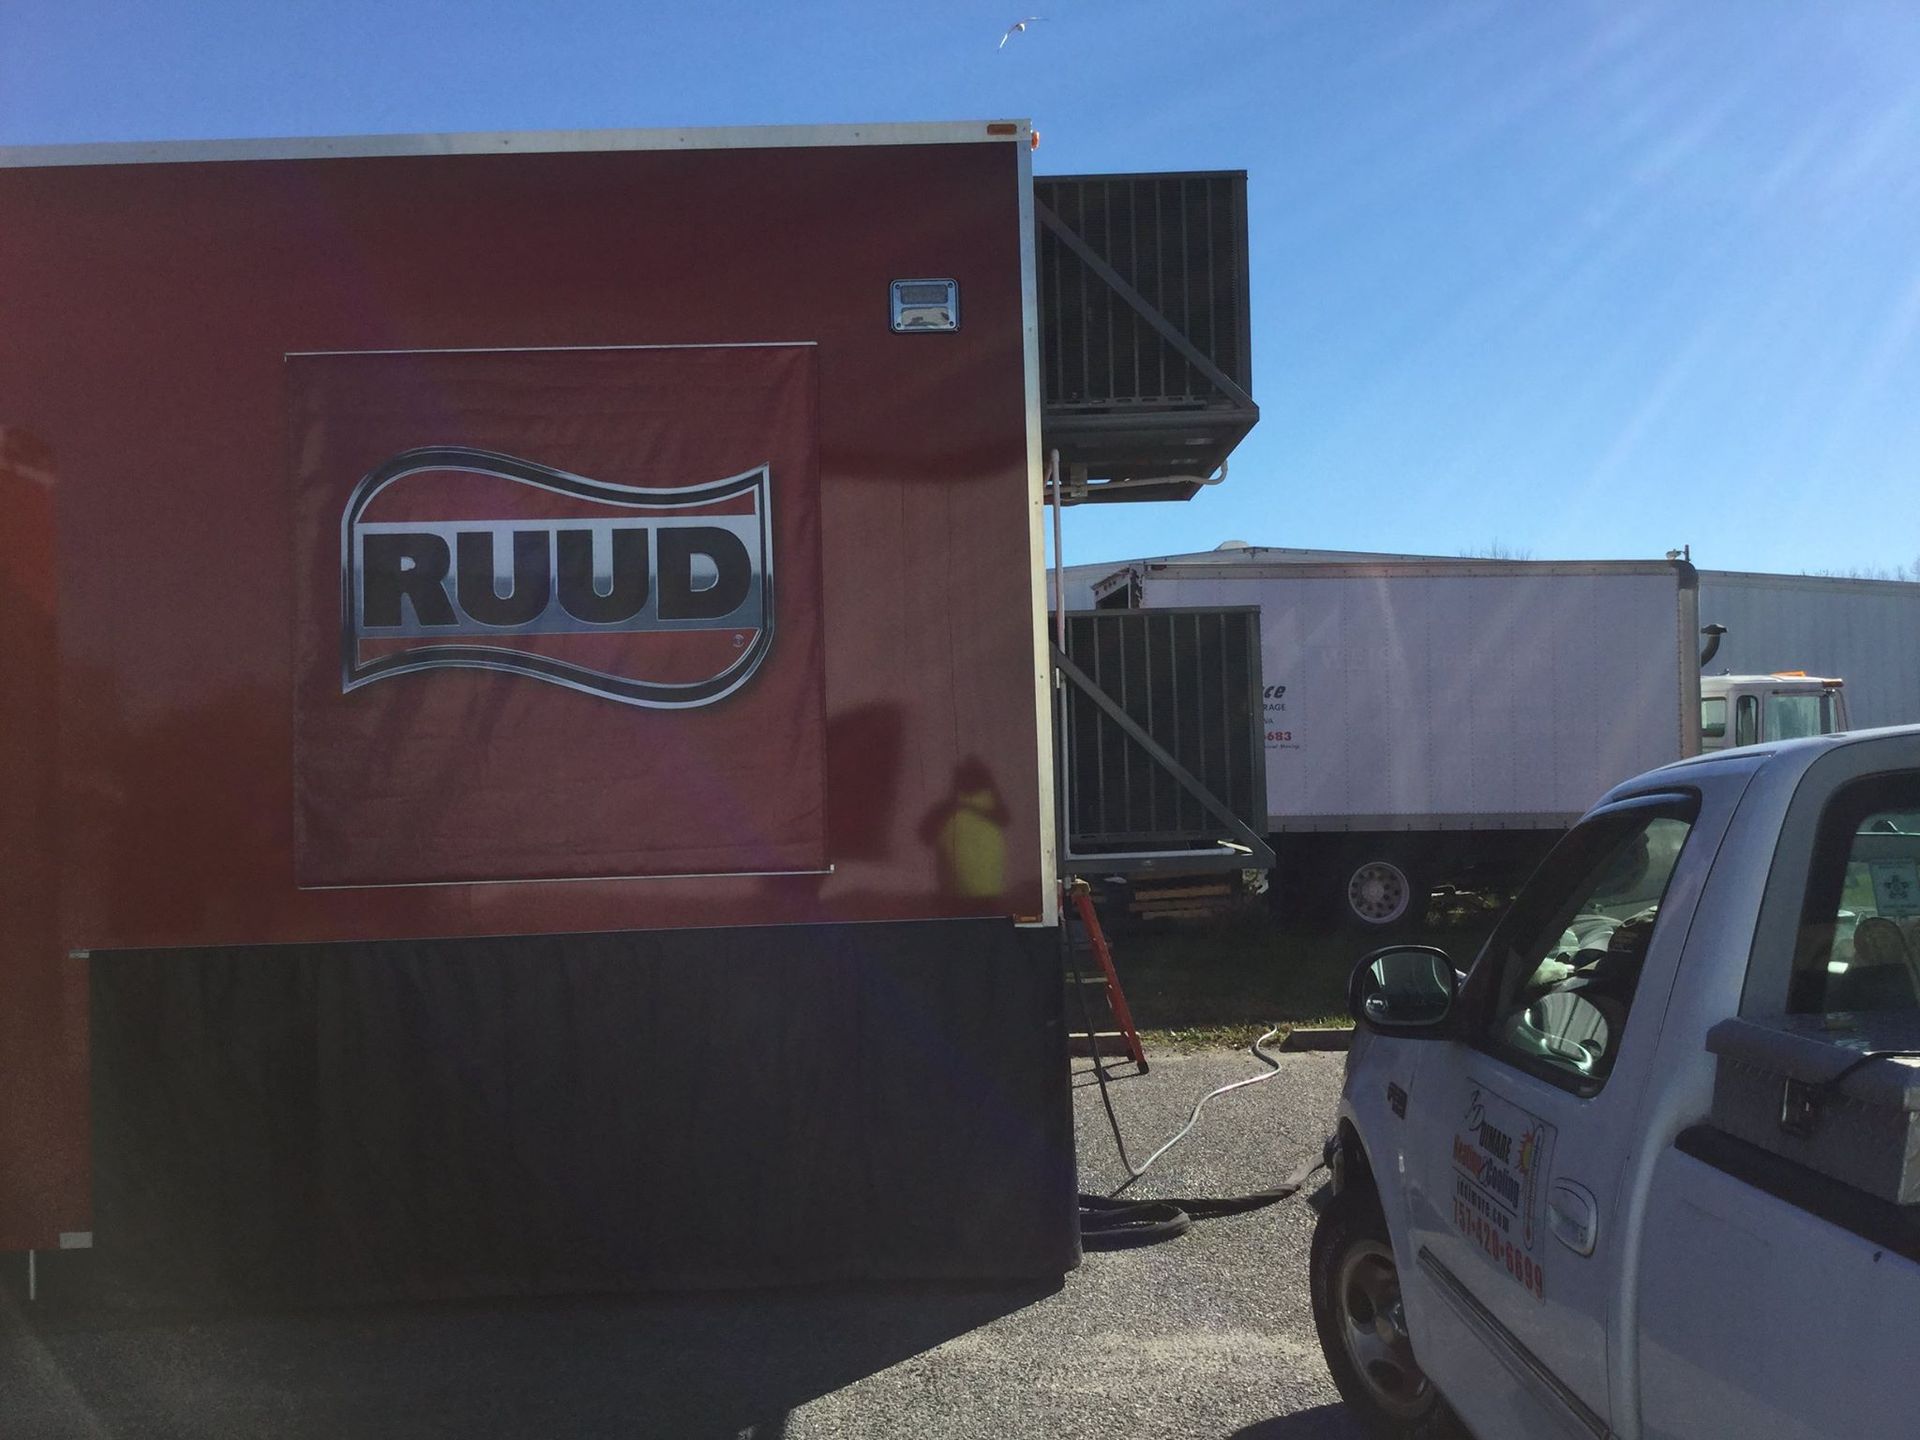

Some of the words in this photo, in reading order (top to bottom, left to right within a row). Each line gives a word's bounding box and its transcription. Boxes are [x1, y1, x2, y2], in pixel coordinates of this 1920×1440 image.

[362, 525, 752, 627] RUUD
[1263, 685, 1286, 699] ce
[1485, 1157, 1520, 1208] Cooling
